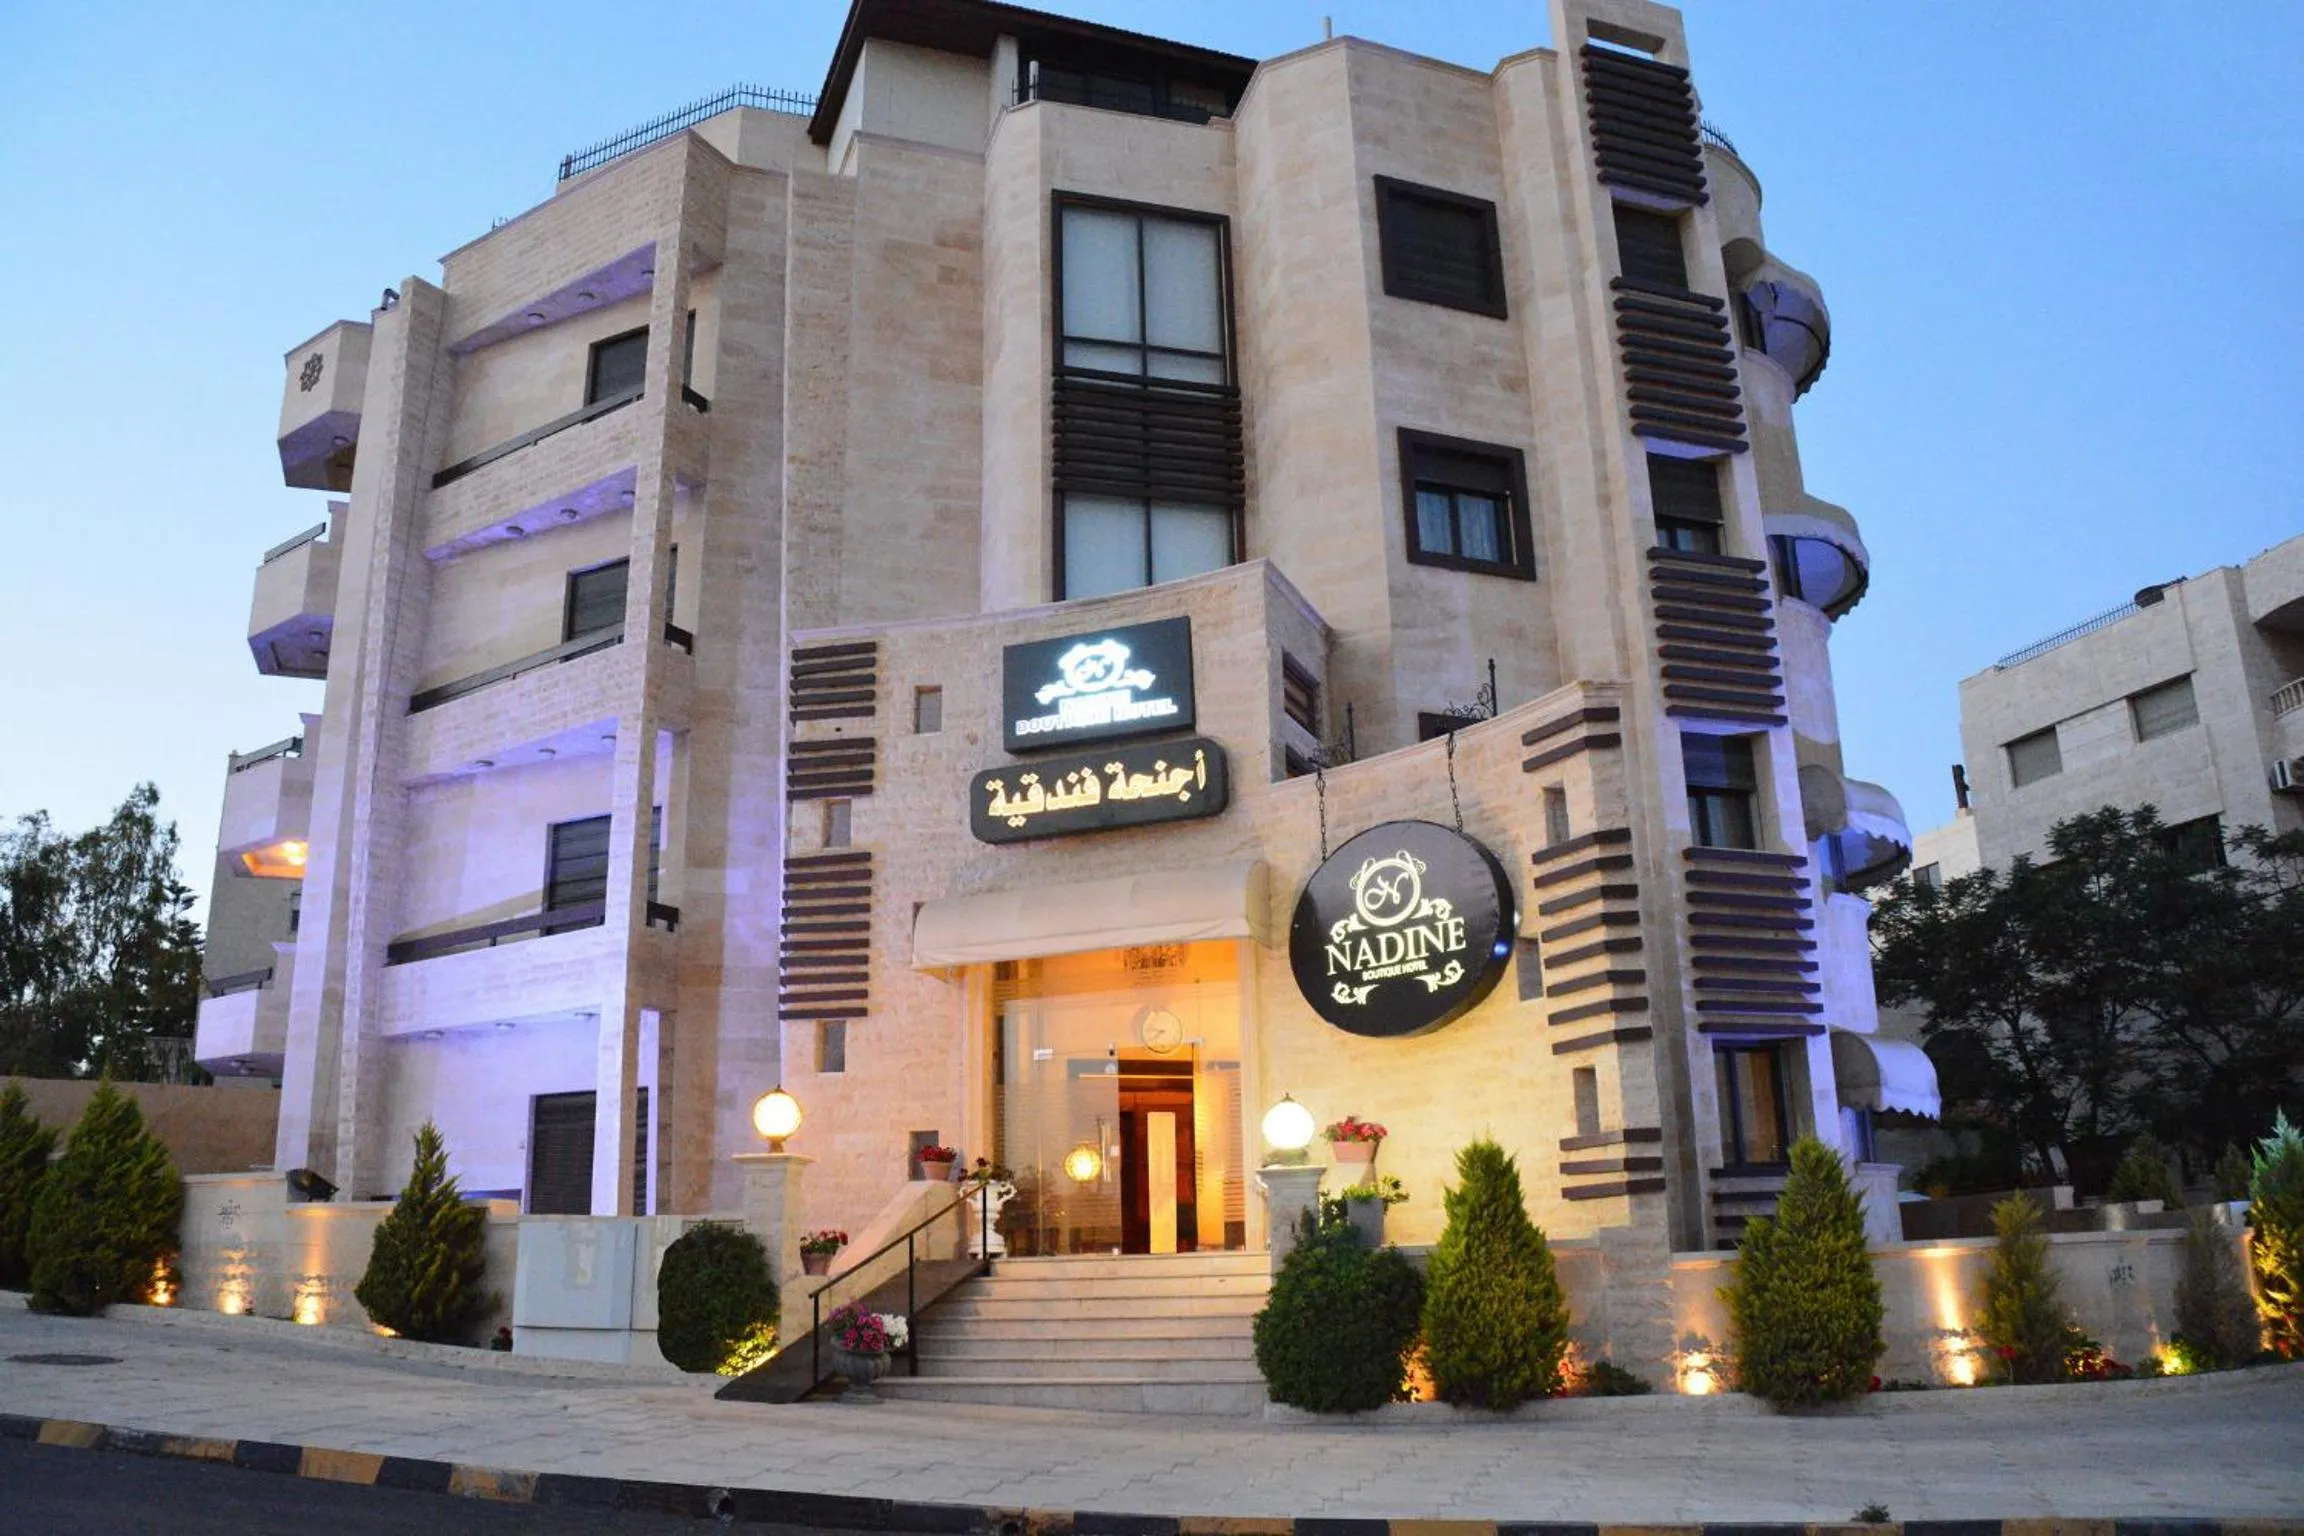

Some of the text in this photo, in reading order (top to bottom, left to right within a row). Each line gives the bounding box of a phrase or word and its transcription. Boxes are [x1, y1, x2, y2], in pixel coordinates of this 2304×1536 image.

[985, 749, 1206, 828] أجنحة فندقية
[1324, 917, 1467, 976] NADINE
